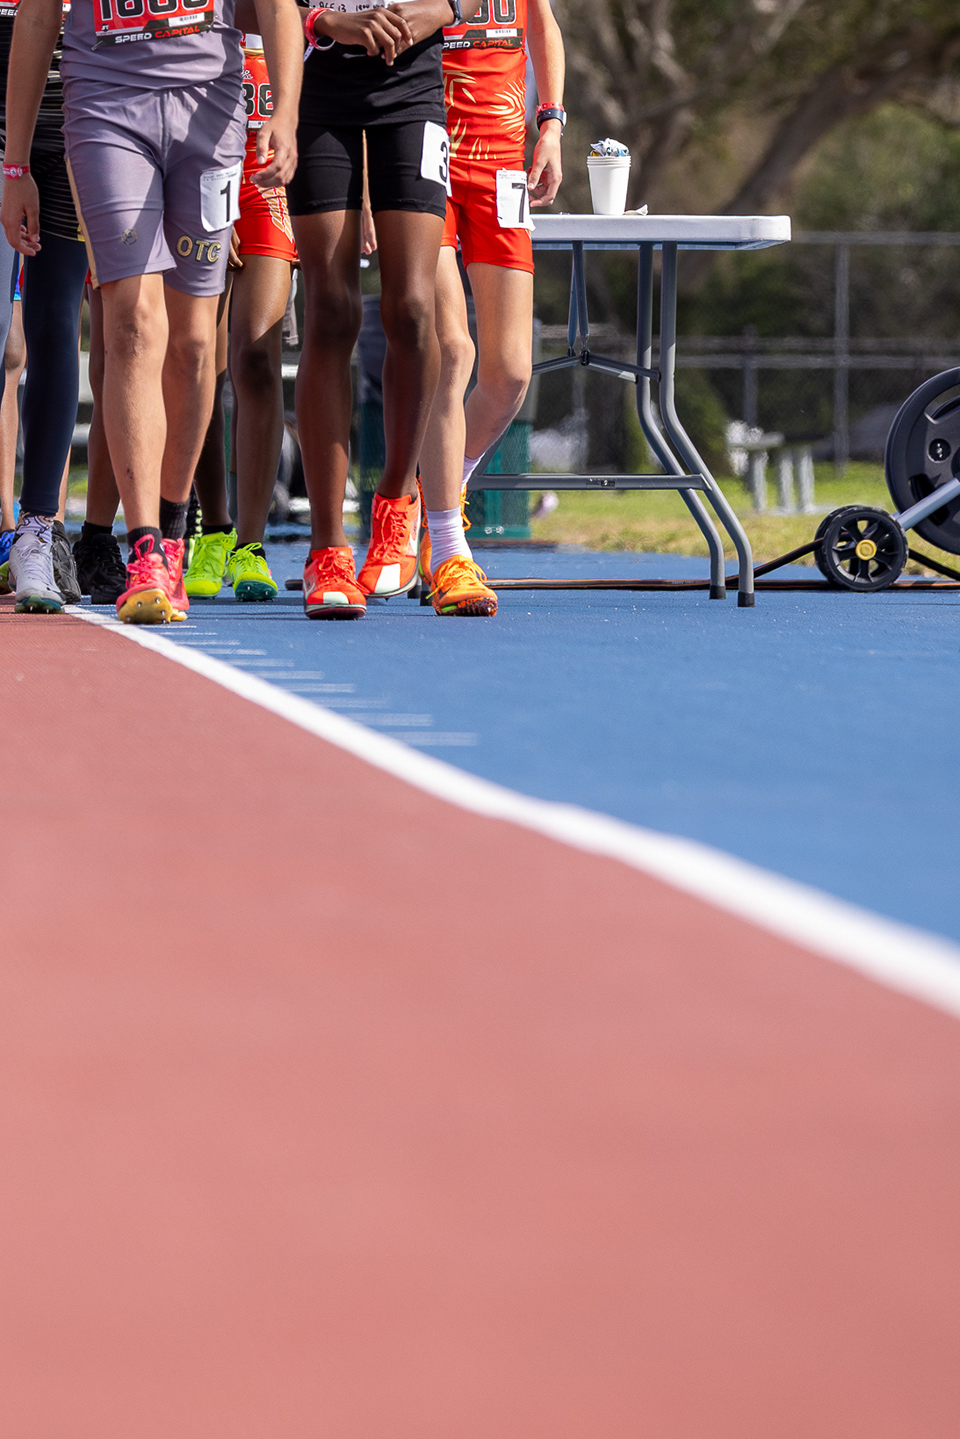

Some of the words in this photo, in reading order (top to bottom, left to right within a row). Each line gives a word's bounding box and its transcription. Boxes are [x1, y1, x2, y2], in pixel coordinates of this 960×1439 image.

[114, 32, 152, 43] SPEED
[154, 25, 200, 39] CAPITAL
[442, 41, 471, 49] PEED
[472, 39, 514, 48] CAPITAL
[220, 180, 232, 223] 1
[511, 182, 526, 223] 7
[177, 235, 222, 263] OTC
